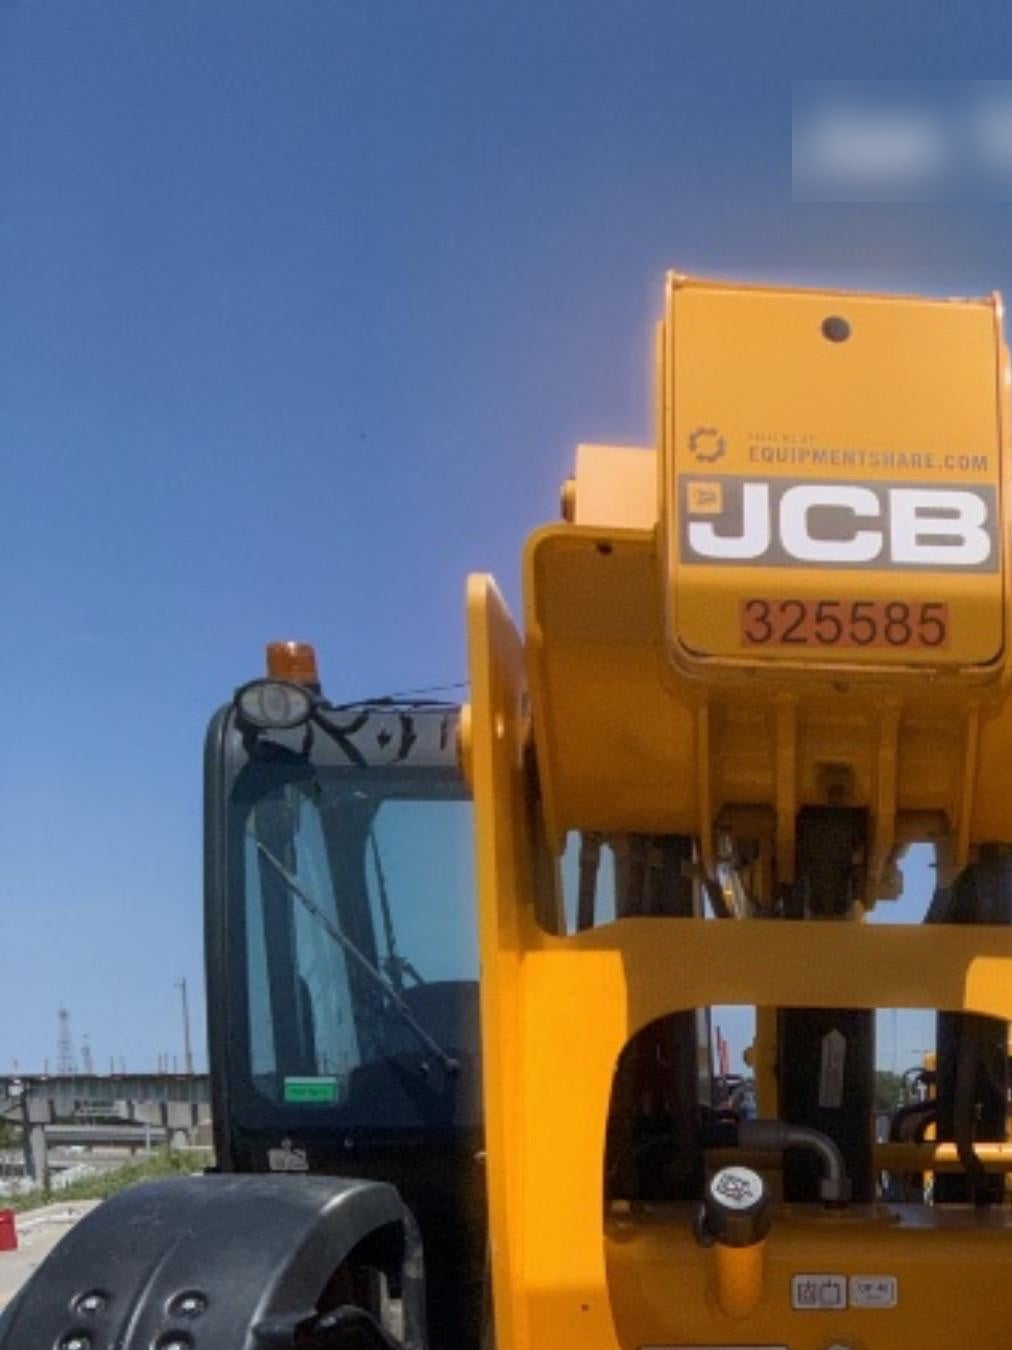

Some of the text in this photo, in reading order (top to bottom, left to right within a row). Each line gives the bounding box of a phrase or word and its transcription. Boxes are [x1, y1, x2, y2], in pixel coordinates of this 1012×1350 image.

[748, 446, 988, 472] EQUIPMENTSHARE.COM
[688, 481, 992, 565] JCB
[743, 599, 946, 647] 325585
